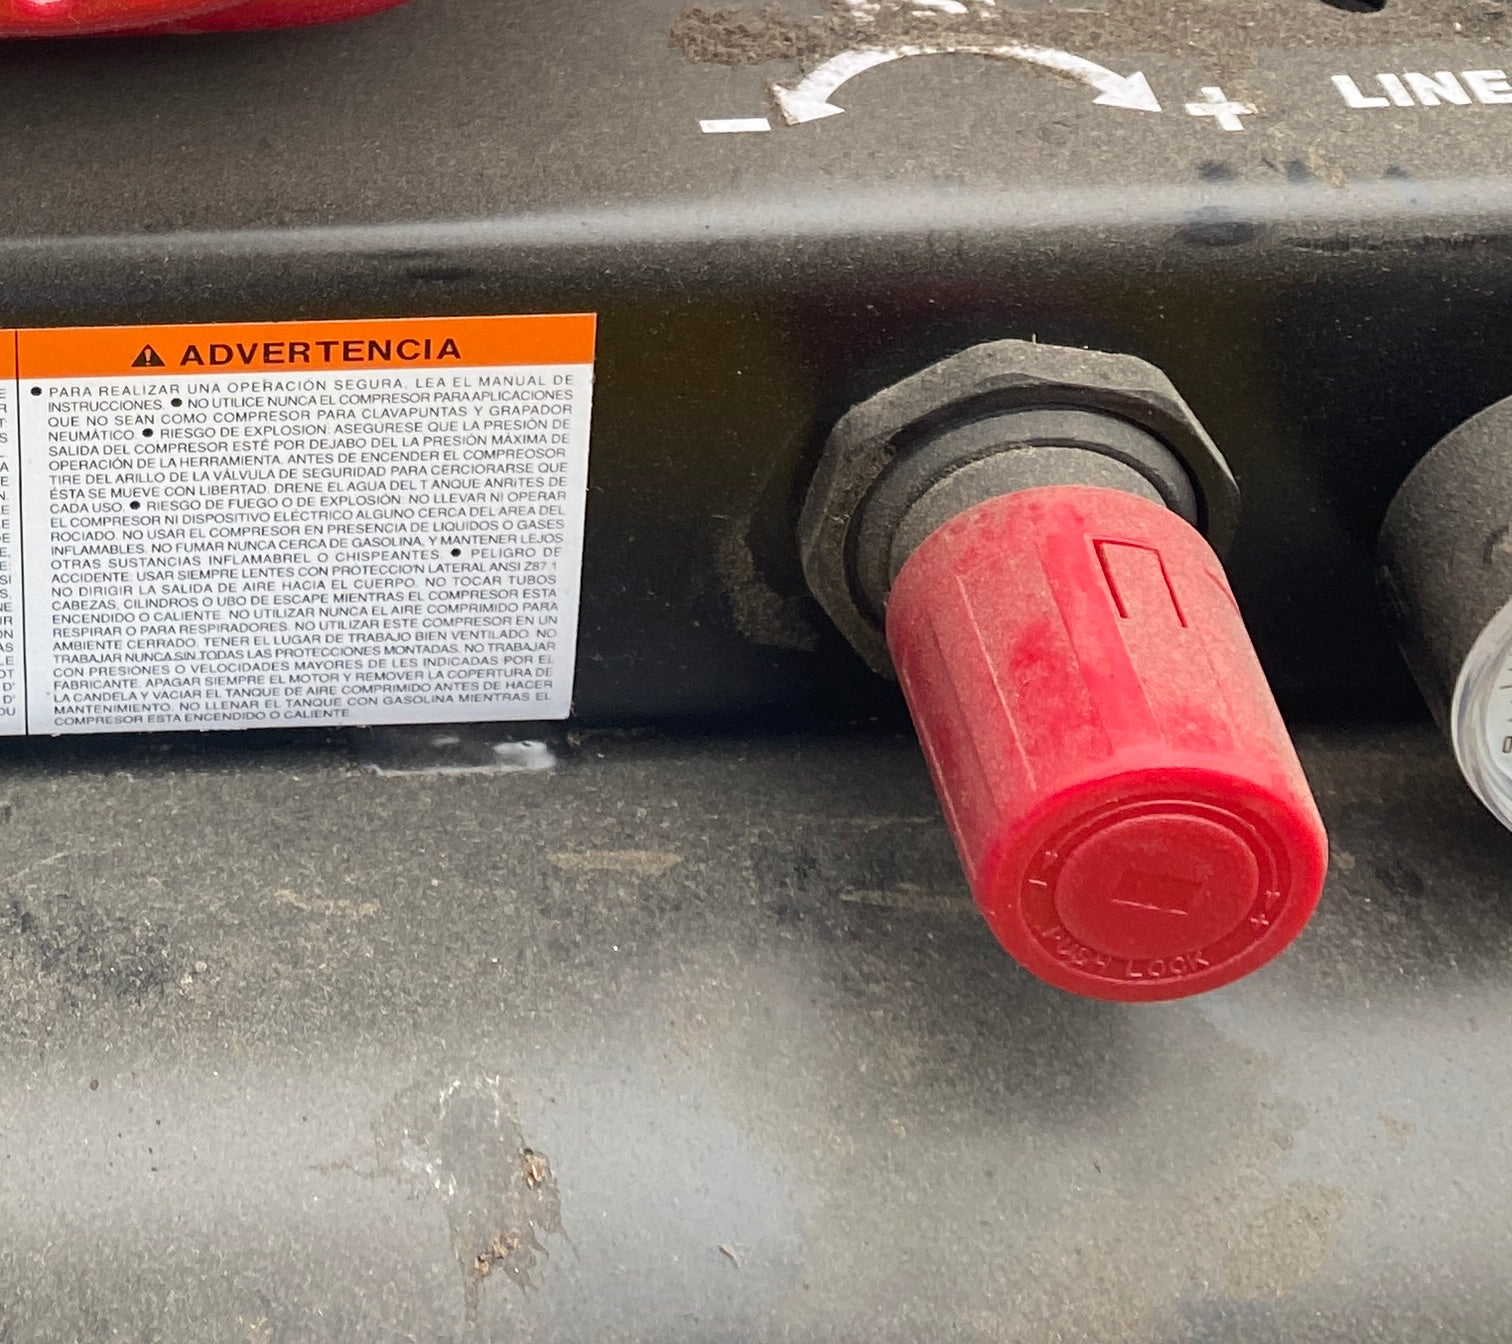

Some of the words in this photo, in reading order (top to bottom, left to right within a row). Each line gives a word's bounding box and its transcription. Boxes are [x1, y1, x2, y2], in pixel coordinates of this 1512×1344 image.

[1331, 68, 1512, 109] LINE
[179, 338, 462, 367] ADVERTENCIA
[47, 415, 78, 427] QUE
[86, 415, 108, 426] NO
[114, 414, 154, 425] SEAN
[160, 412, 207, 424] COMO
[212, 410, 310, 423] COMPRESOR
[317, 408, 355, 419] PARA
[361, 406, 467, 419] CLAVAPUNTAS
[473, 406, 482, 415] Y
[488, 404, 572, 416] GRAPADOR
